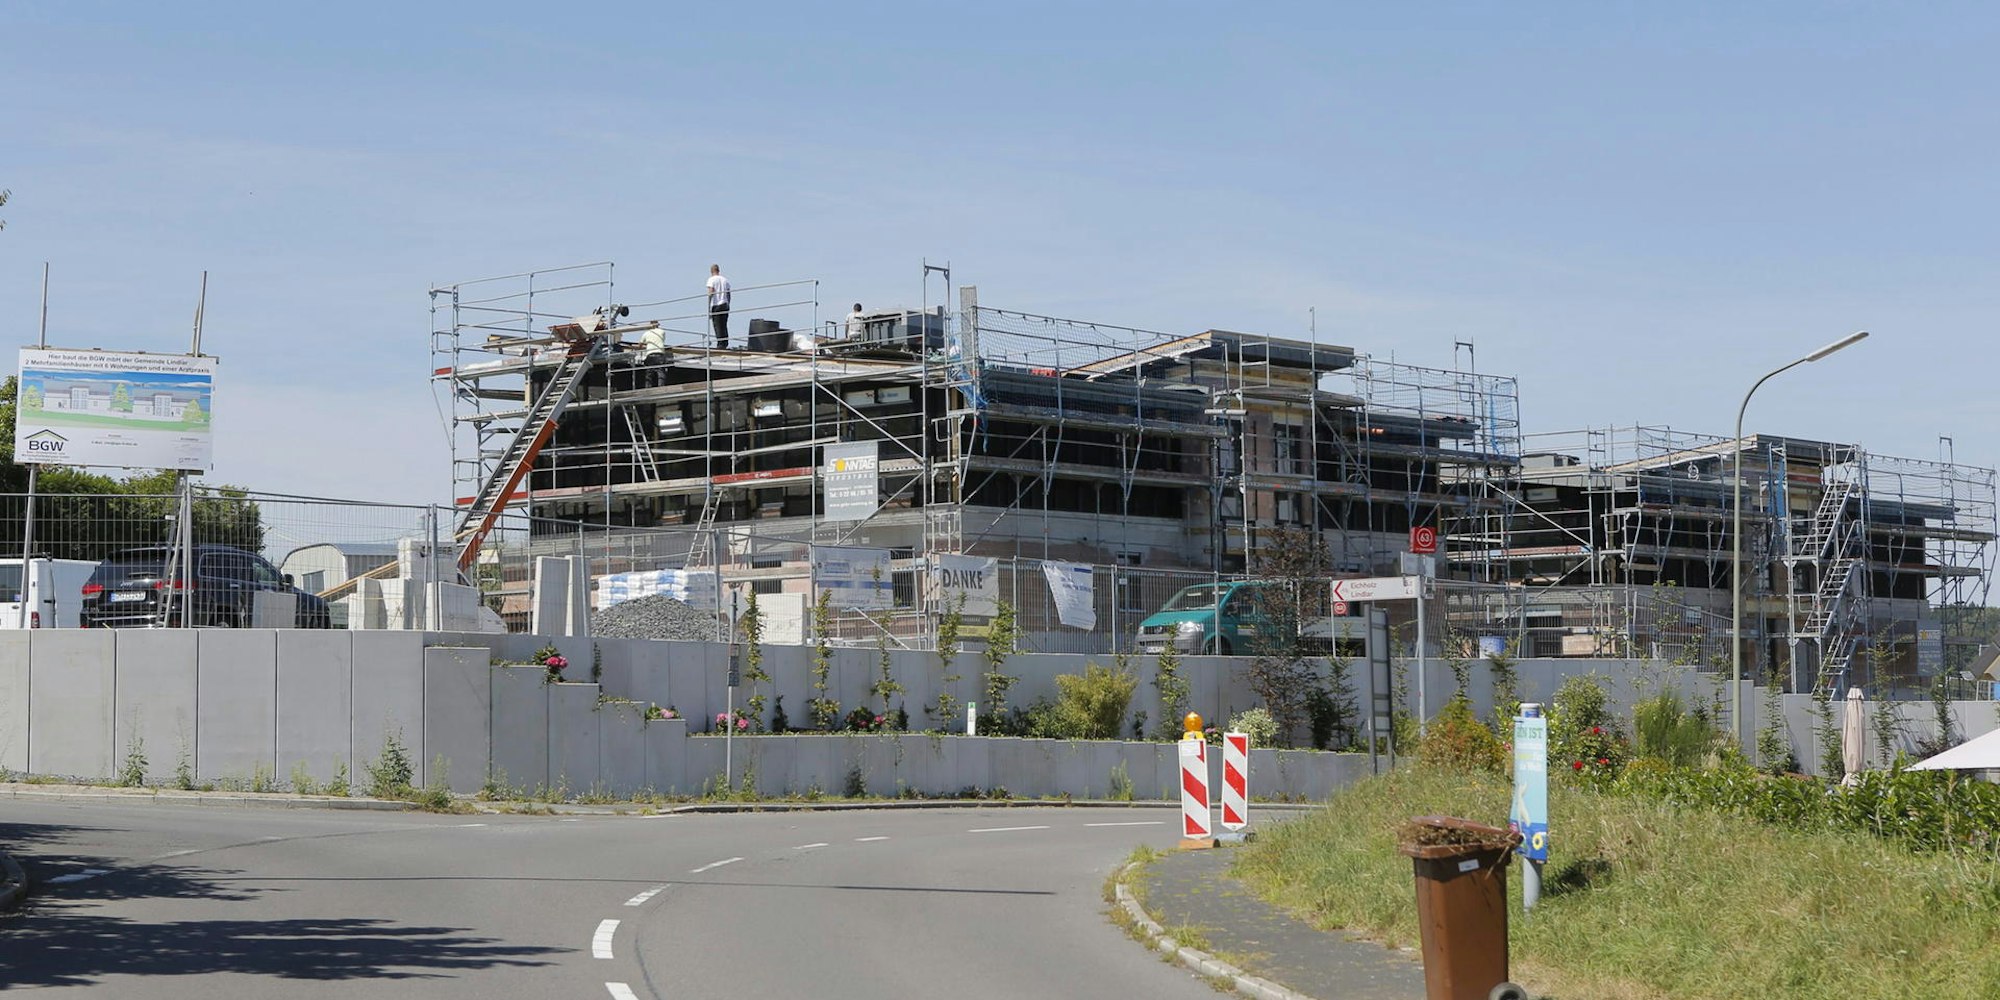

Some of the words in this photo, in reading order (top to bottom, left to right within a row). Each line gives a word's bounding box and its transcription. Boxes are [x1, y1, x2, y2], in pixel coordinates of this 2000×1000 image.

[31, 359, 92, 368] Mehrfamilienhäuser
[110, 363, 148, 371] Wohnungen
[178, 366, 210, 374] Arztpraxis
[28, 440, 64, 452] BGW
[827, 457, 876, 472] SONNTAG
[1420, 533, 1429, 542] 63
[942, 568, 983, 590] DANKE
